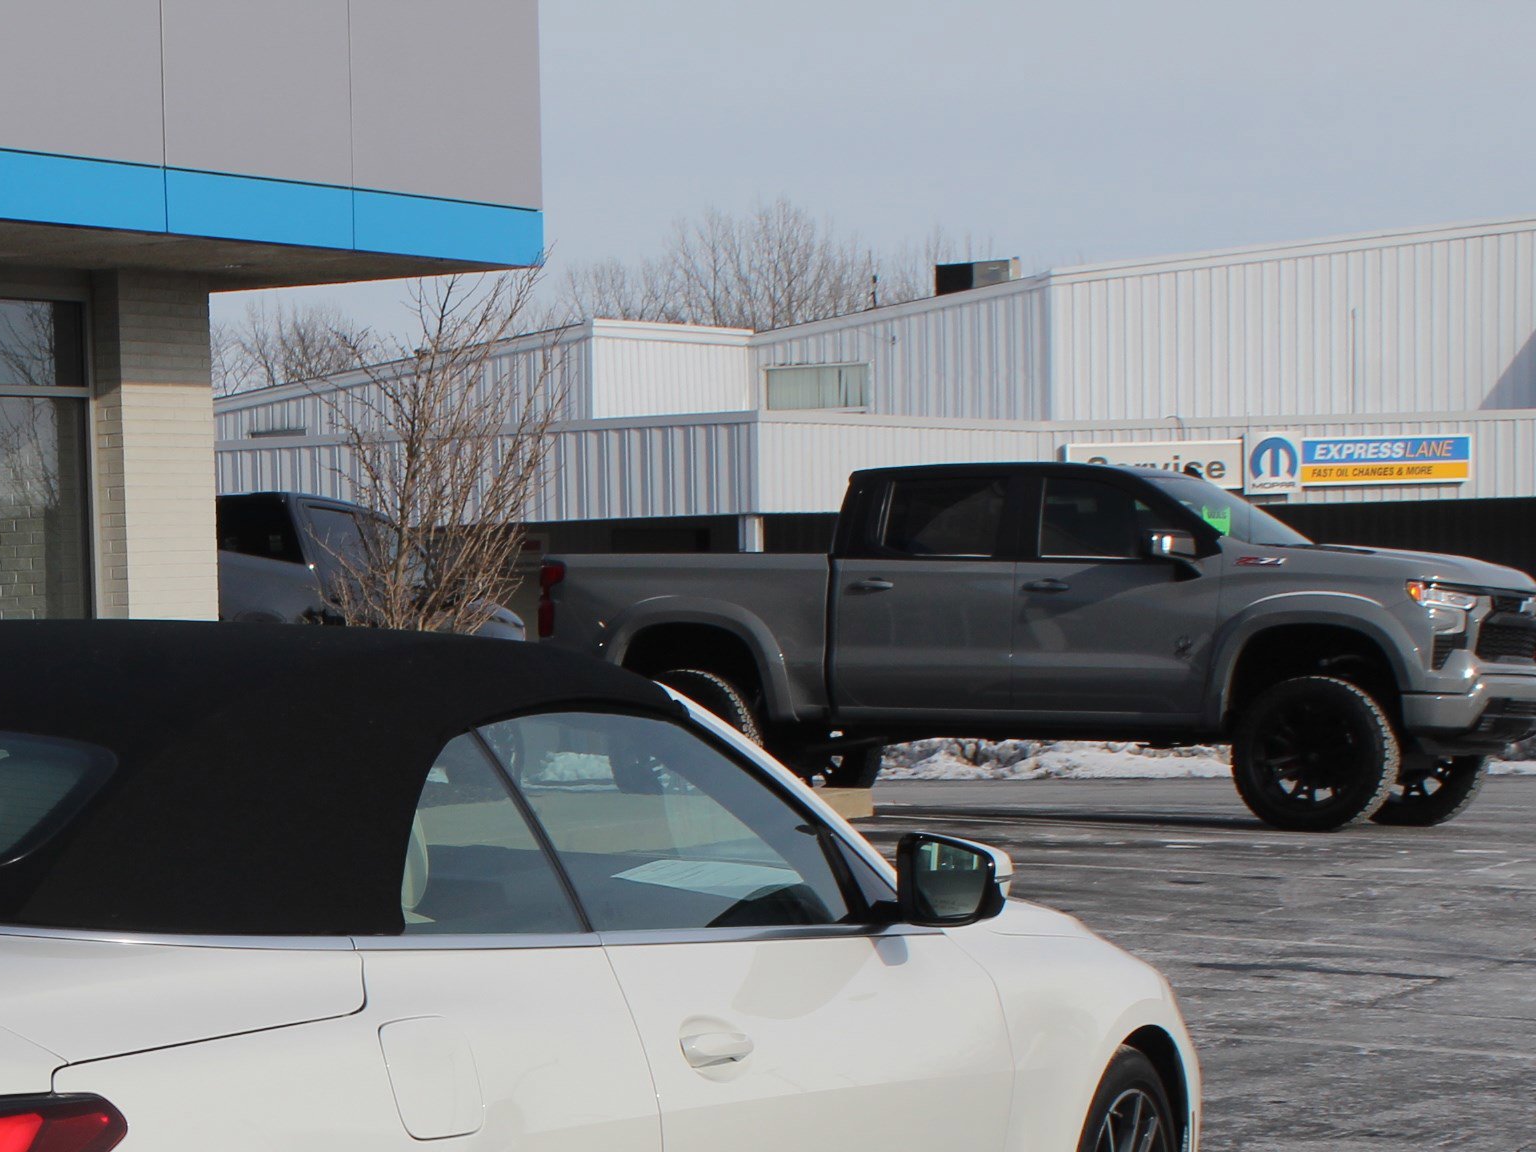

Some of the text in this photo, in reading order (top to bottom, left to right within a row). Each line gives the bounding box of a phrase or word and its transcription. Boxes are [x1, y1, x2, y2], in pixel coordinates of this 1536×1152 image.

[1311, 465, 1433, 478] FAST OIL CHANGES & MORE
[1251, 481, 1297, 490] MOPAR
[1235, 556, 1287, 568] Z71
